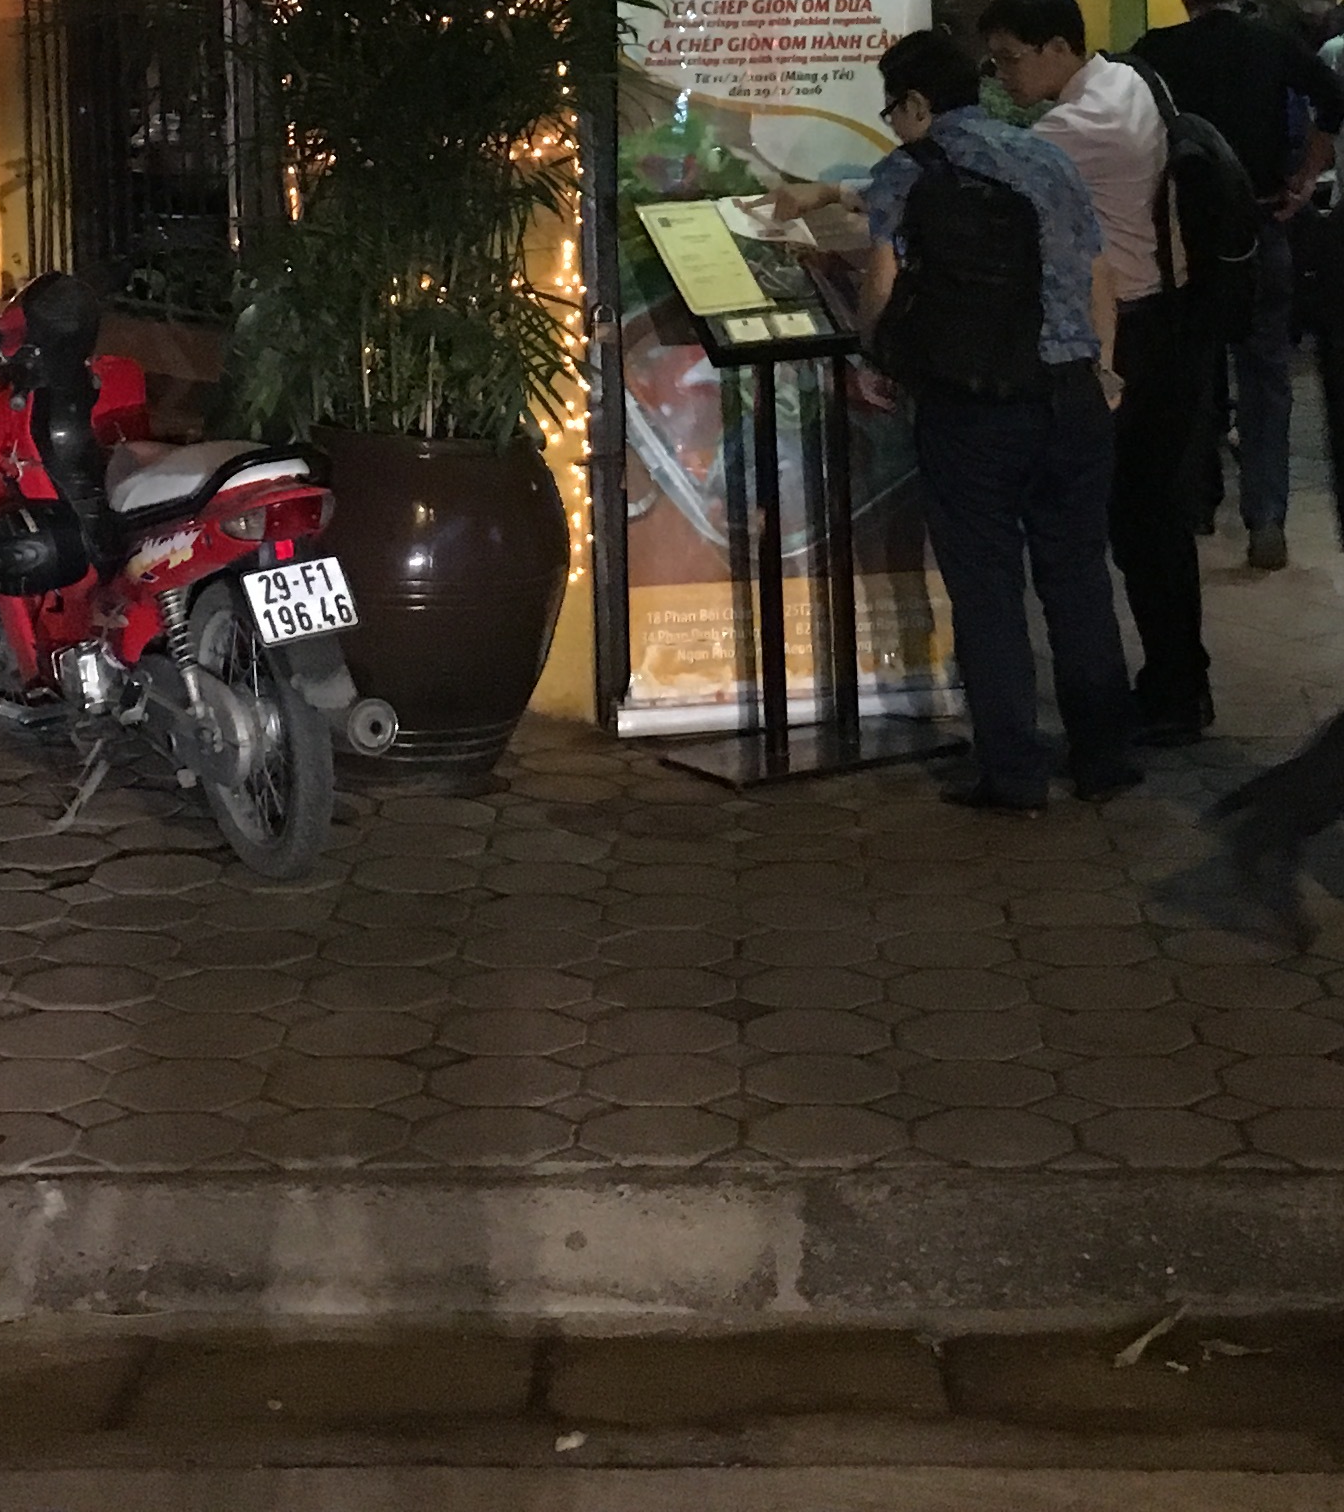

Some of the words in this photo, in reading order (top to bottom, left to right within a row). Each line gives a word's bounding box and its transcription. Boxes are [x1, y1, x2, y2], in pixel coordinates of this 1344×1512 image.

[647, 34, 671, 54] CÁ
[676, 34, 724, 53] CHÉP
[727, 33, 774, 52] GIÒN
[778, 35, 807, 50] OM
[811, 31, 862, 49] HÀNH
[258, 562, 333, 605] 29-F1
[263, 594, 353, 639] 196.46
[664, 610, 696, 623] Phan
